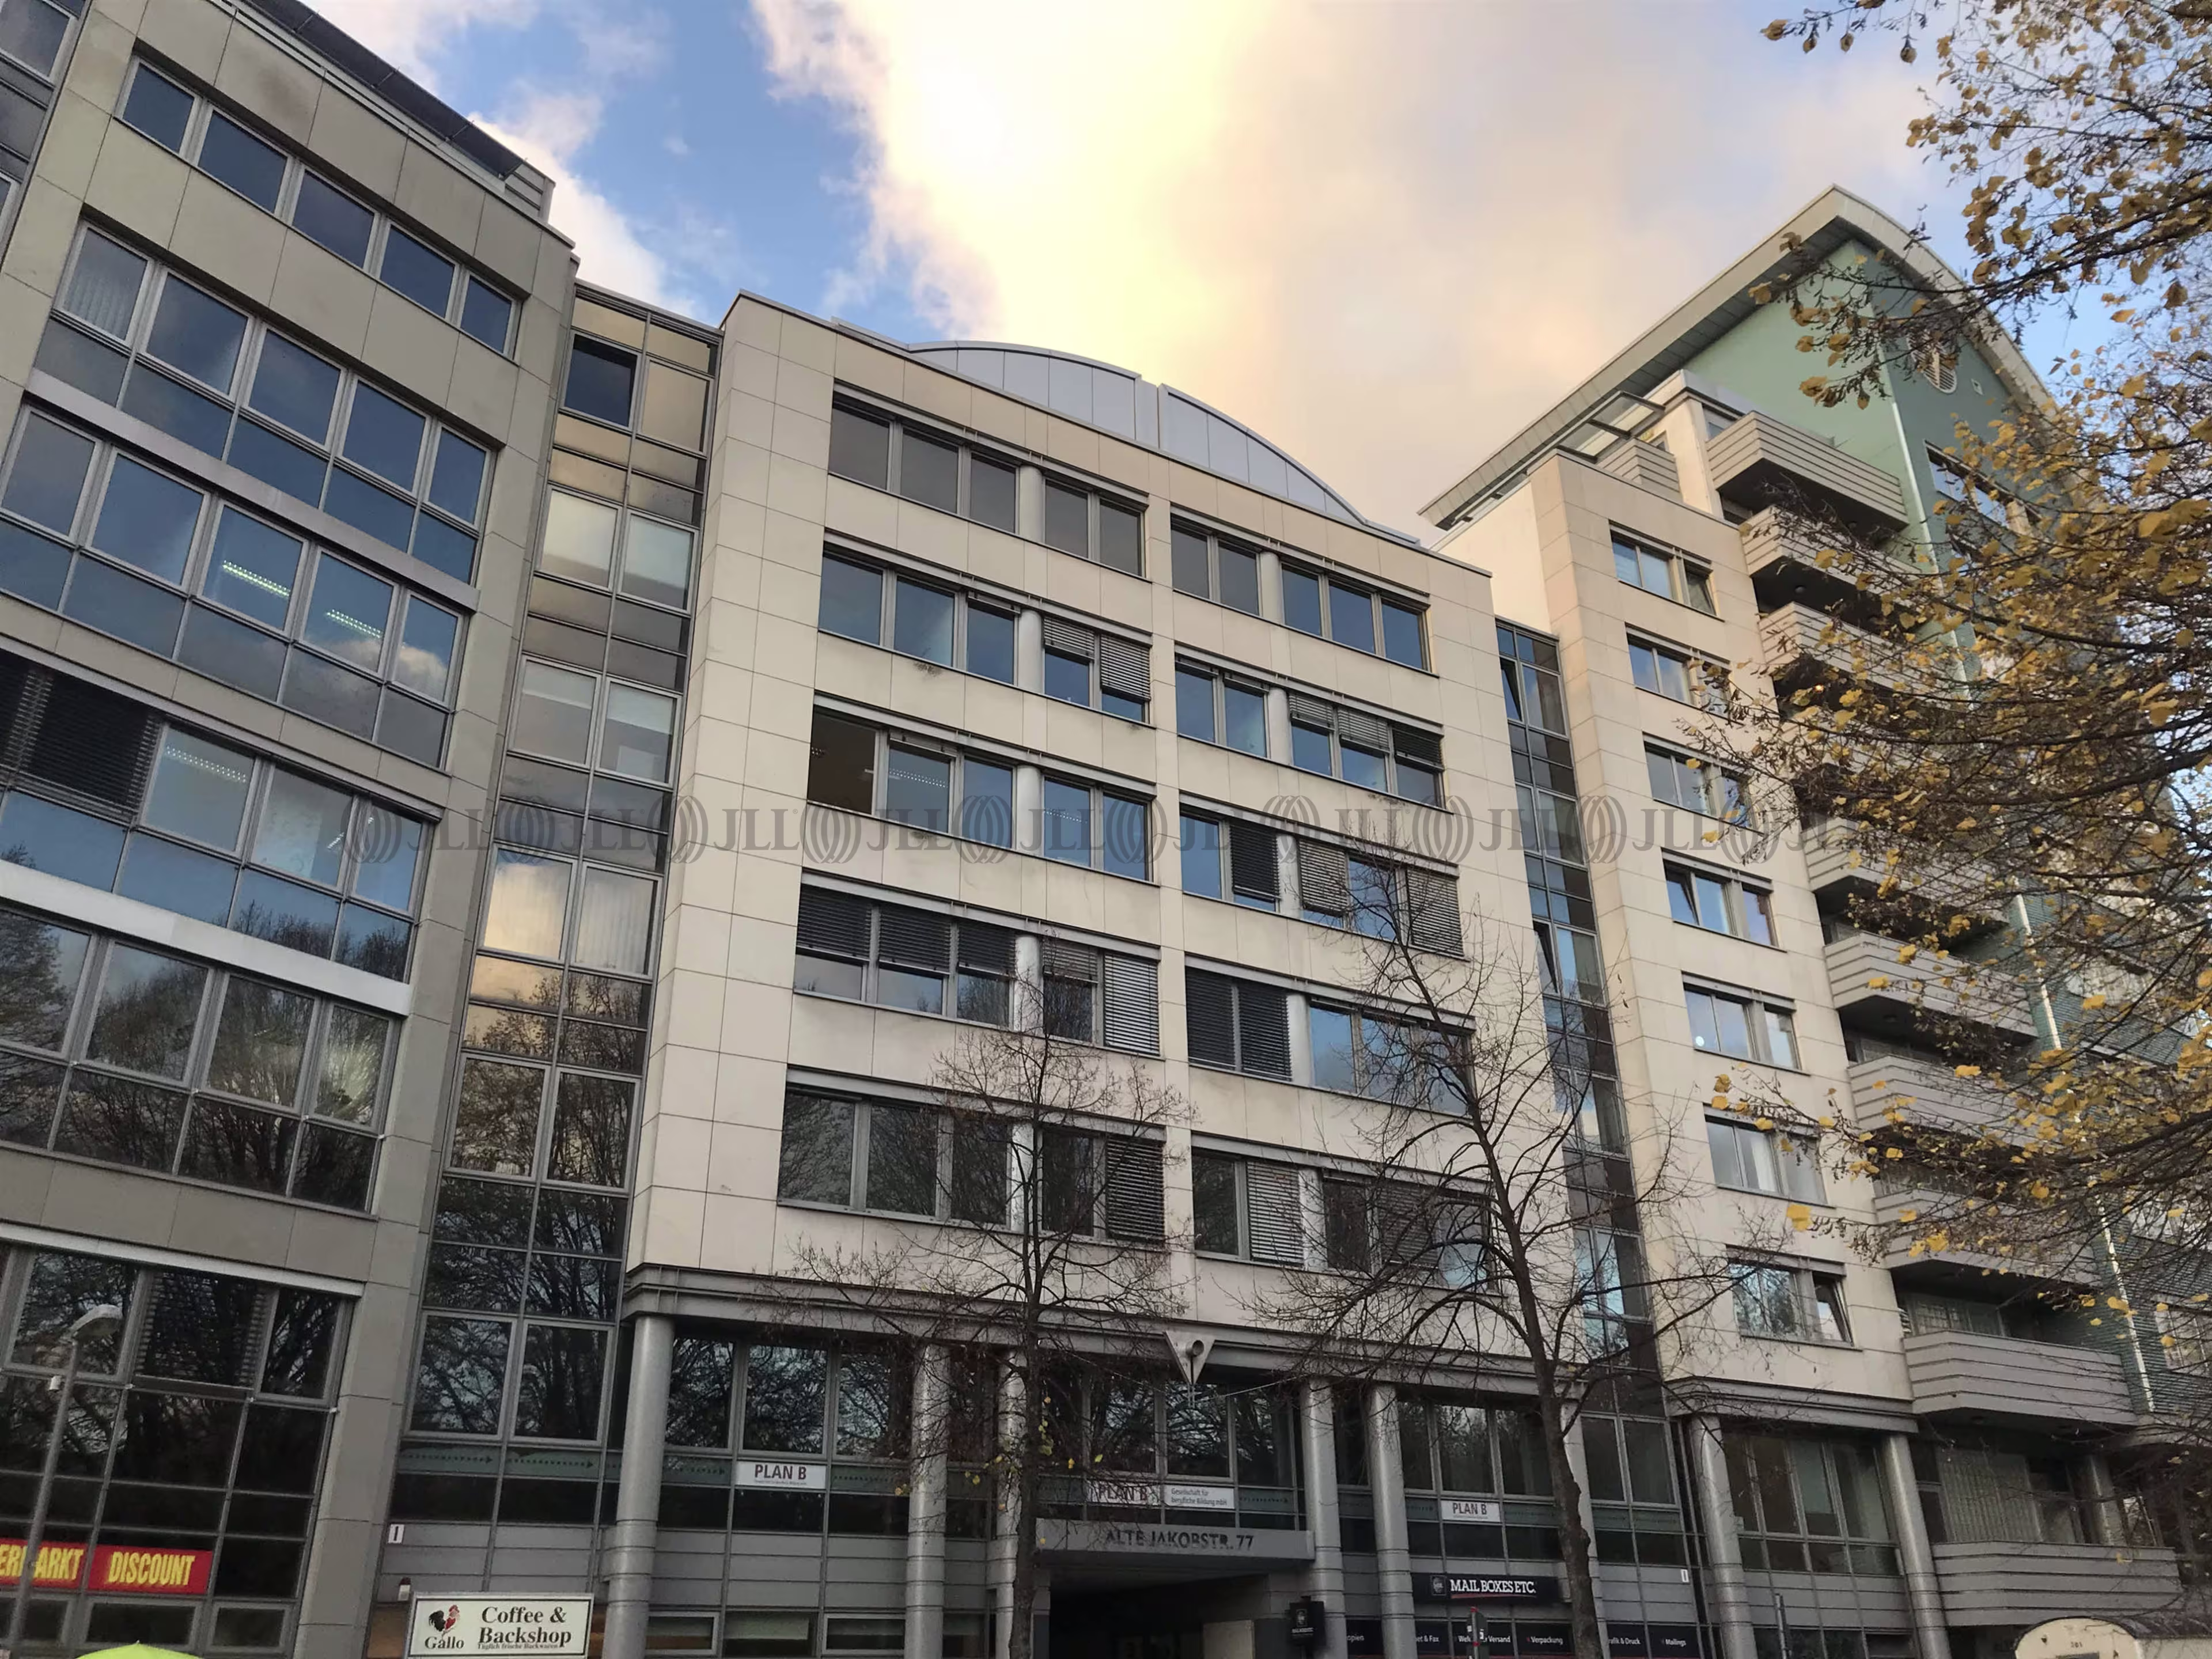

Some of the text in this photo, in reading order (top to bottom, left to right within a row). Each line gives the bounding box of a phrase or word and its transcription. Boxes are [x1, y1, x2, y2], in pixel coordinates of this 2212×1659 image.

[755, 1464, 806, 1480] PLAN B
[1453, 1502, 1487, 1514] PLAN B
[1106, 1529, 1144, 1546] ALTE
[1236, 1535, 1254, 1550] 77
[109, 1551, 195, 1585] DISCOUNT
[1450, 1580, 1479, 1592] MAIL
[1480, 1580, 1514, 1593] BOXES
[482, 1607, 566, 1623] Coffee &
[425, 1636, 464, 1649] Gallo
[479, 1627, 571, 1647] Backshop
[1531, 1637, 1563, 1645] Verpackung
